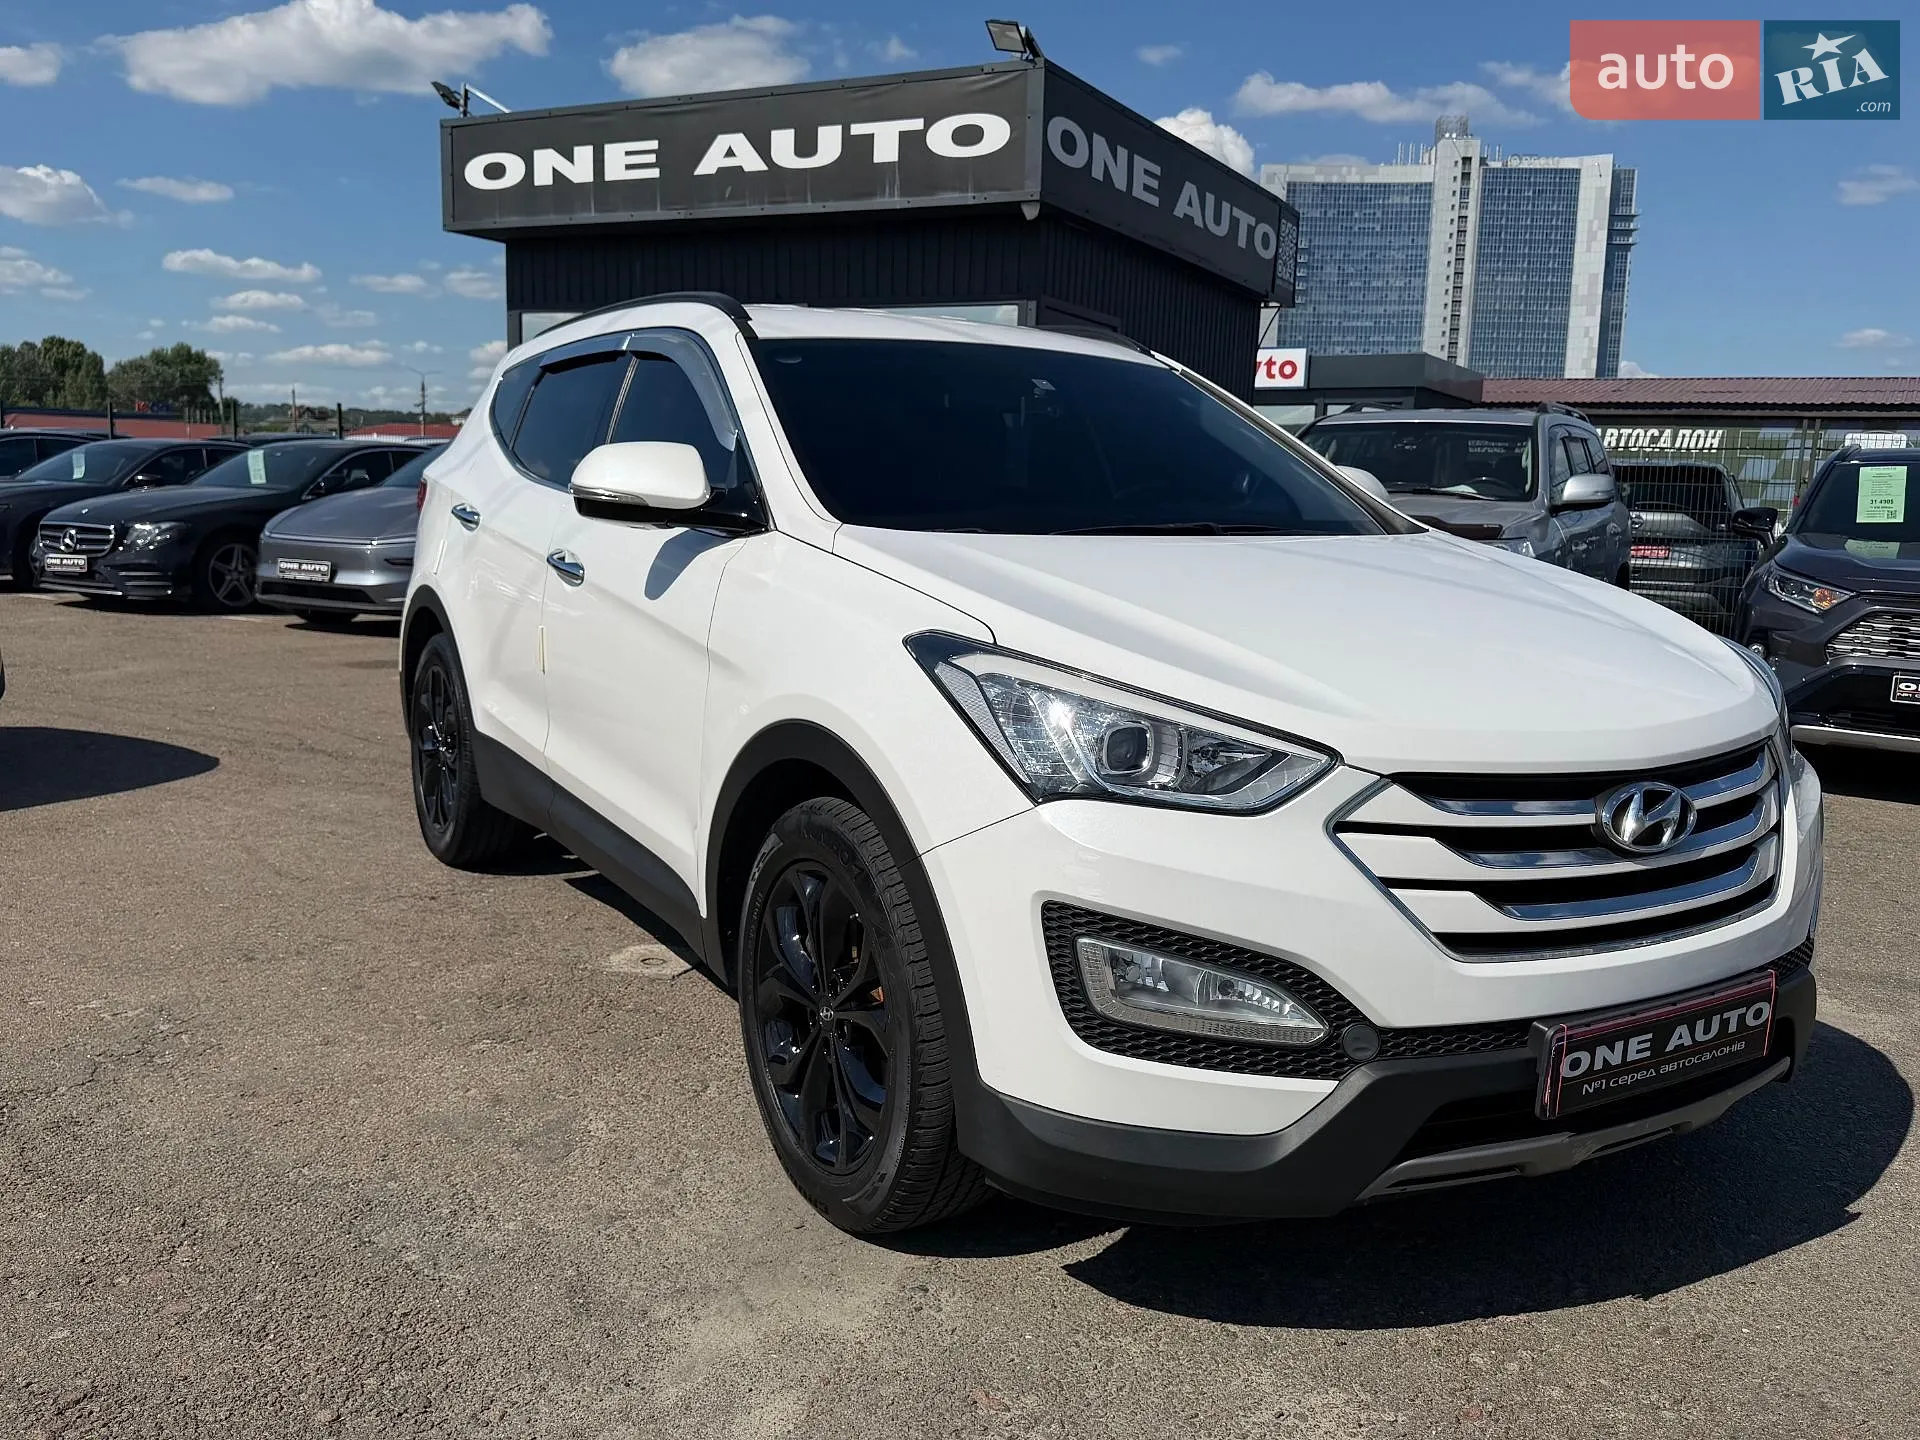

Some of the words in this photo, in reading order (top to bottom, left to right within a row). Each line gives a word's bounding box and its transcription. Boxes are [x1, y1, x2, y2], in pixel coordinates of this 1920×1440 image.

[464, 139, 661, 191] ONE
[693, 113, 1011, 176] AUTO
[1046, 115, 1162, 208] ONE
[1173, 181, 1276, 260] AUTO
[1562, 1032, 1653, 1078] ONE
[1664, 1001, 1771, 1053] AUTO
[1582, 1080, 1606, 1095] №1
[1609, 1068, 1656, 1088] серед
[1660, 1040, 1745, 1073] автосалонів
